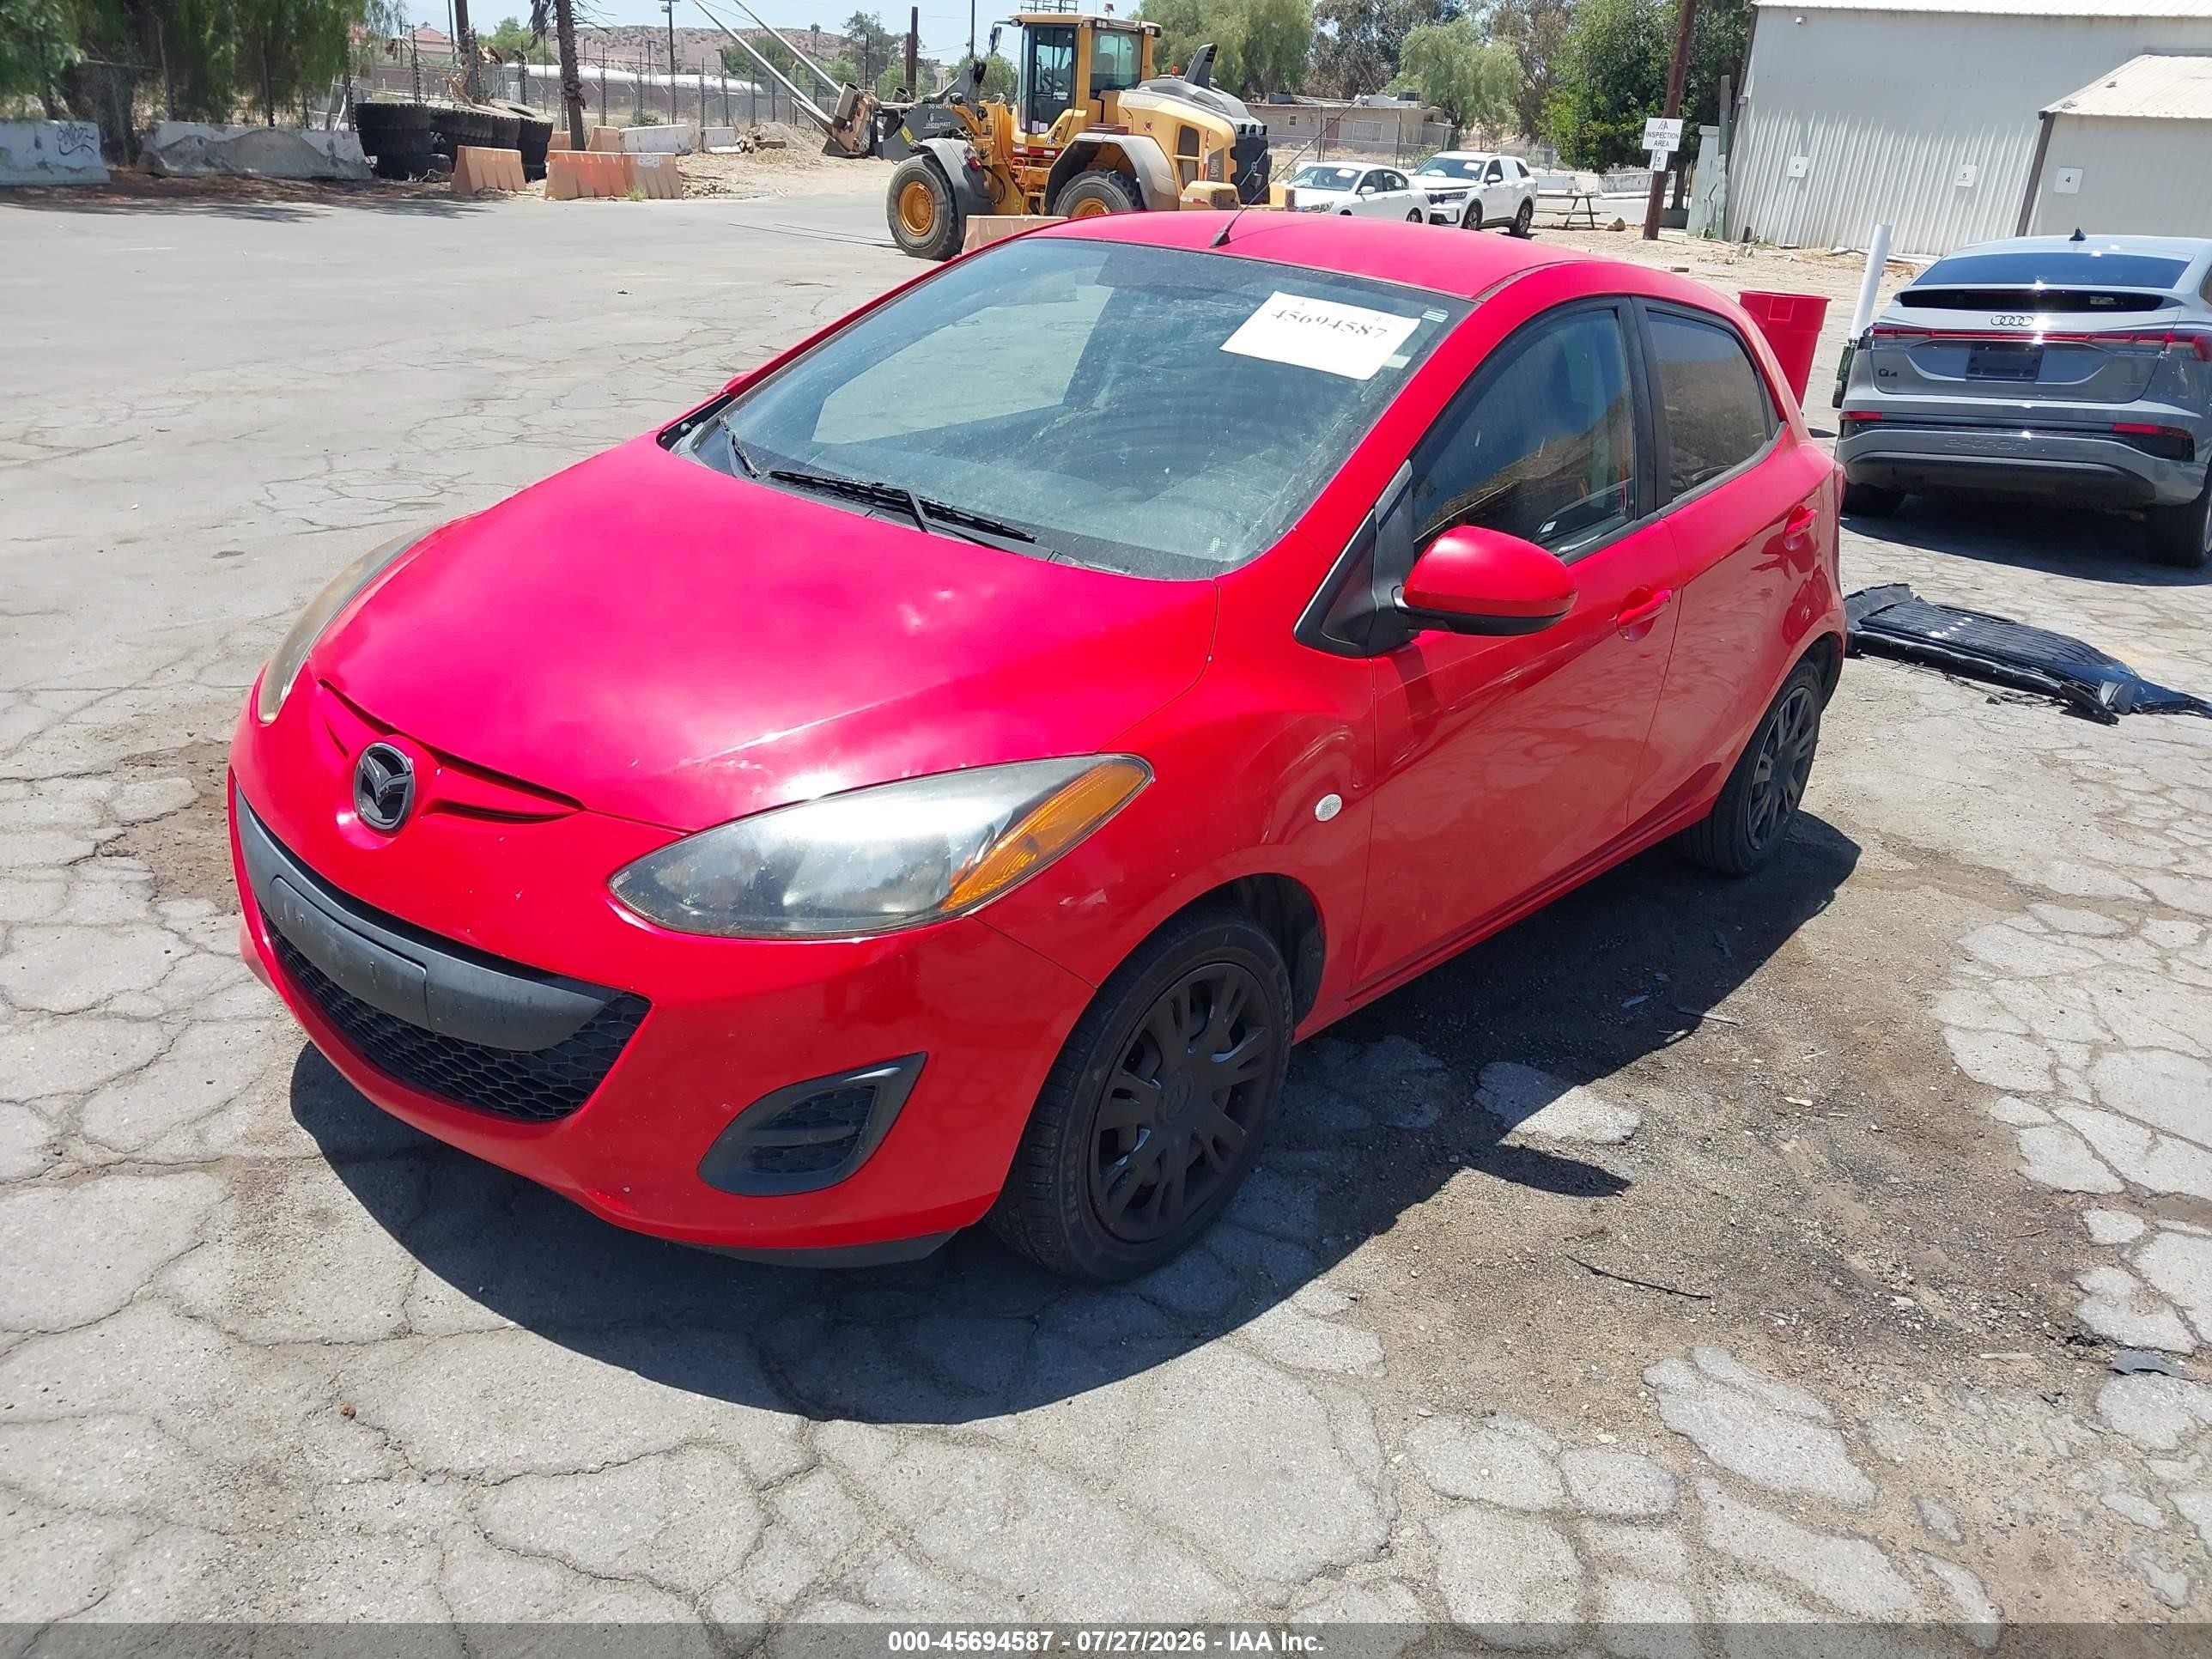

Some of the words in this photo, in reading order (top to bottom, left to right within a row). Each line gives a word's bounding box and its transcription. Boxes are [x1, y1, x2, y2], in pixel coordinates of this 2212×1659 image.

[1645, 131, 1680, 140] INSPECTION
[1271, 310, 1388, 338] 45694587
[1878, 368, 1898, 378] Q4
